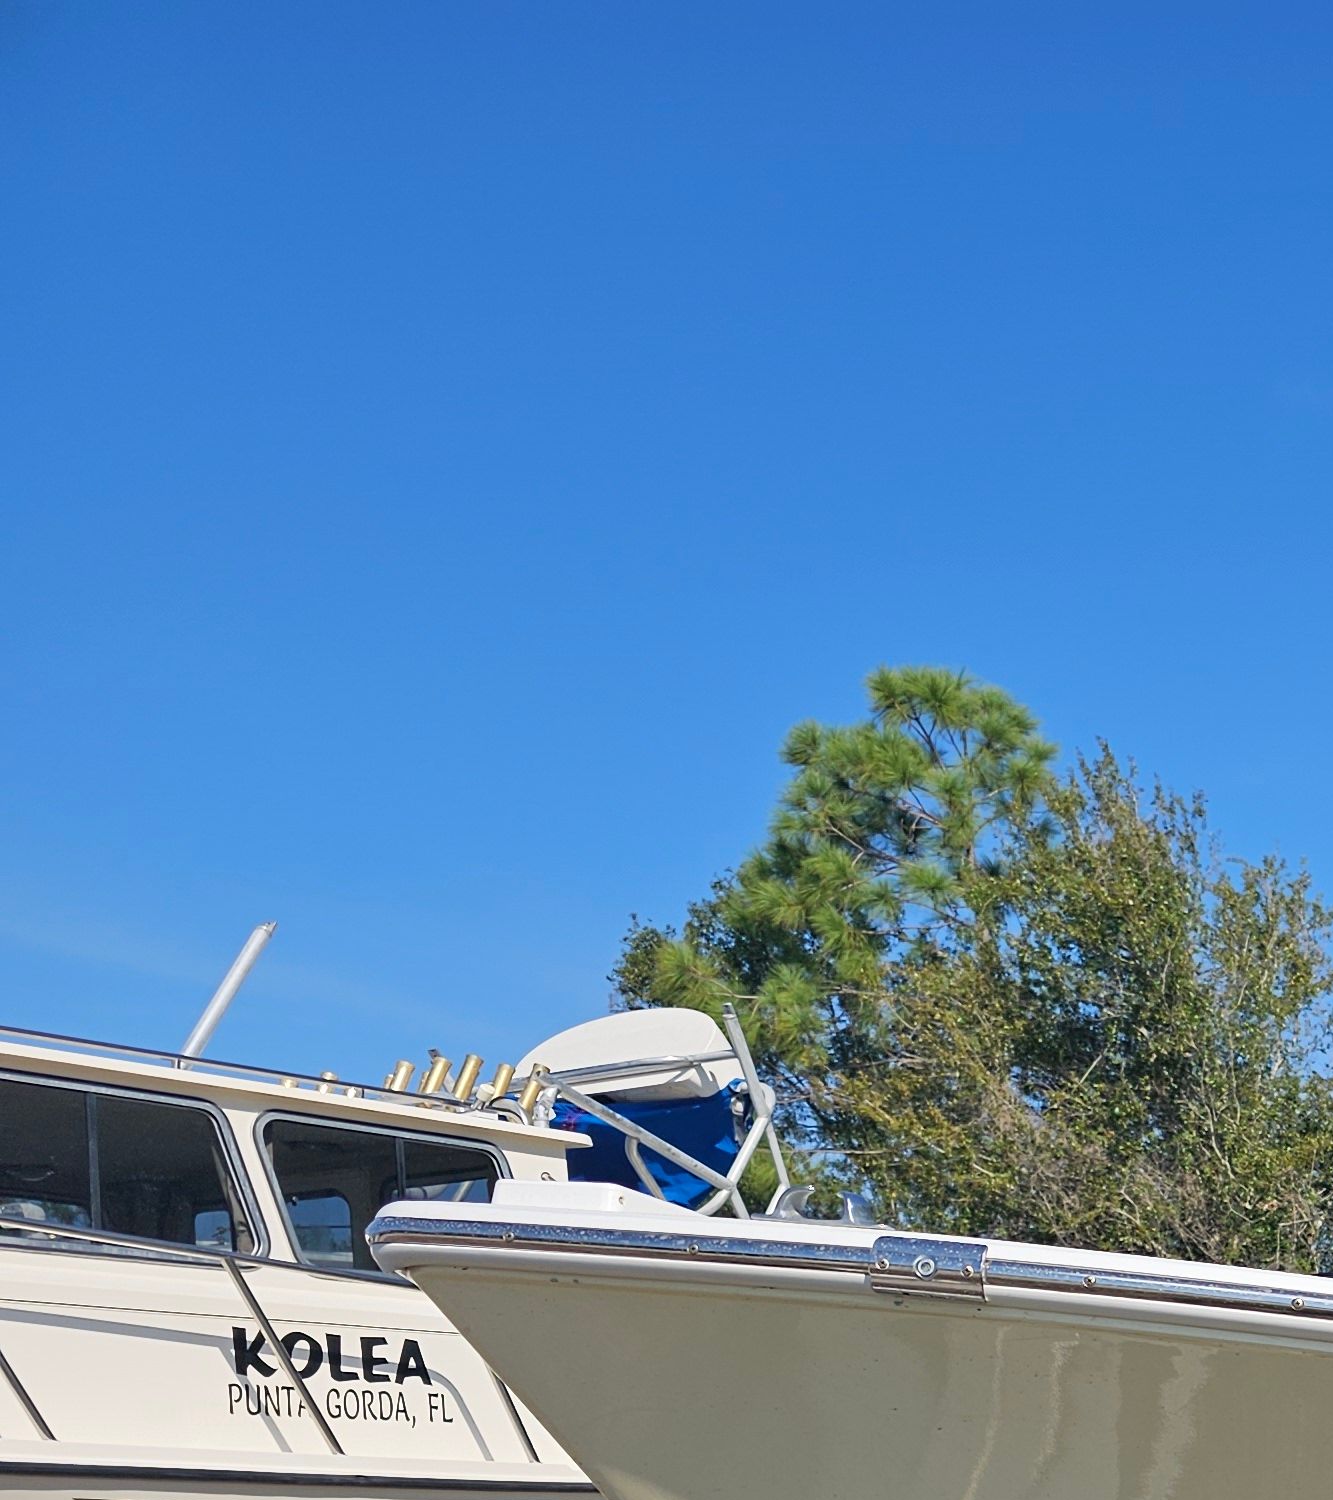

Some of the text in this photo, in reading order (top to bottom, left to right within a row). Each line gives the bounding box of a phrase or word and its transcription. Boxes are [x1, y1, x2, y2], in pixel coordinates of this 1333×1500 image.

[231, 1326, 433, 1386] KOLEA
[326, 1388, 416, 1429] GORDA,
[427, 1392, 454, 1423] FL
